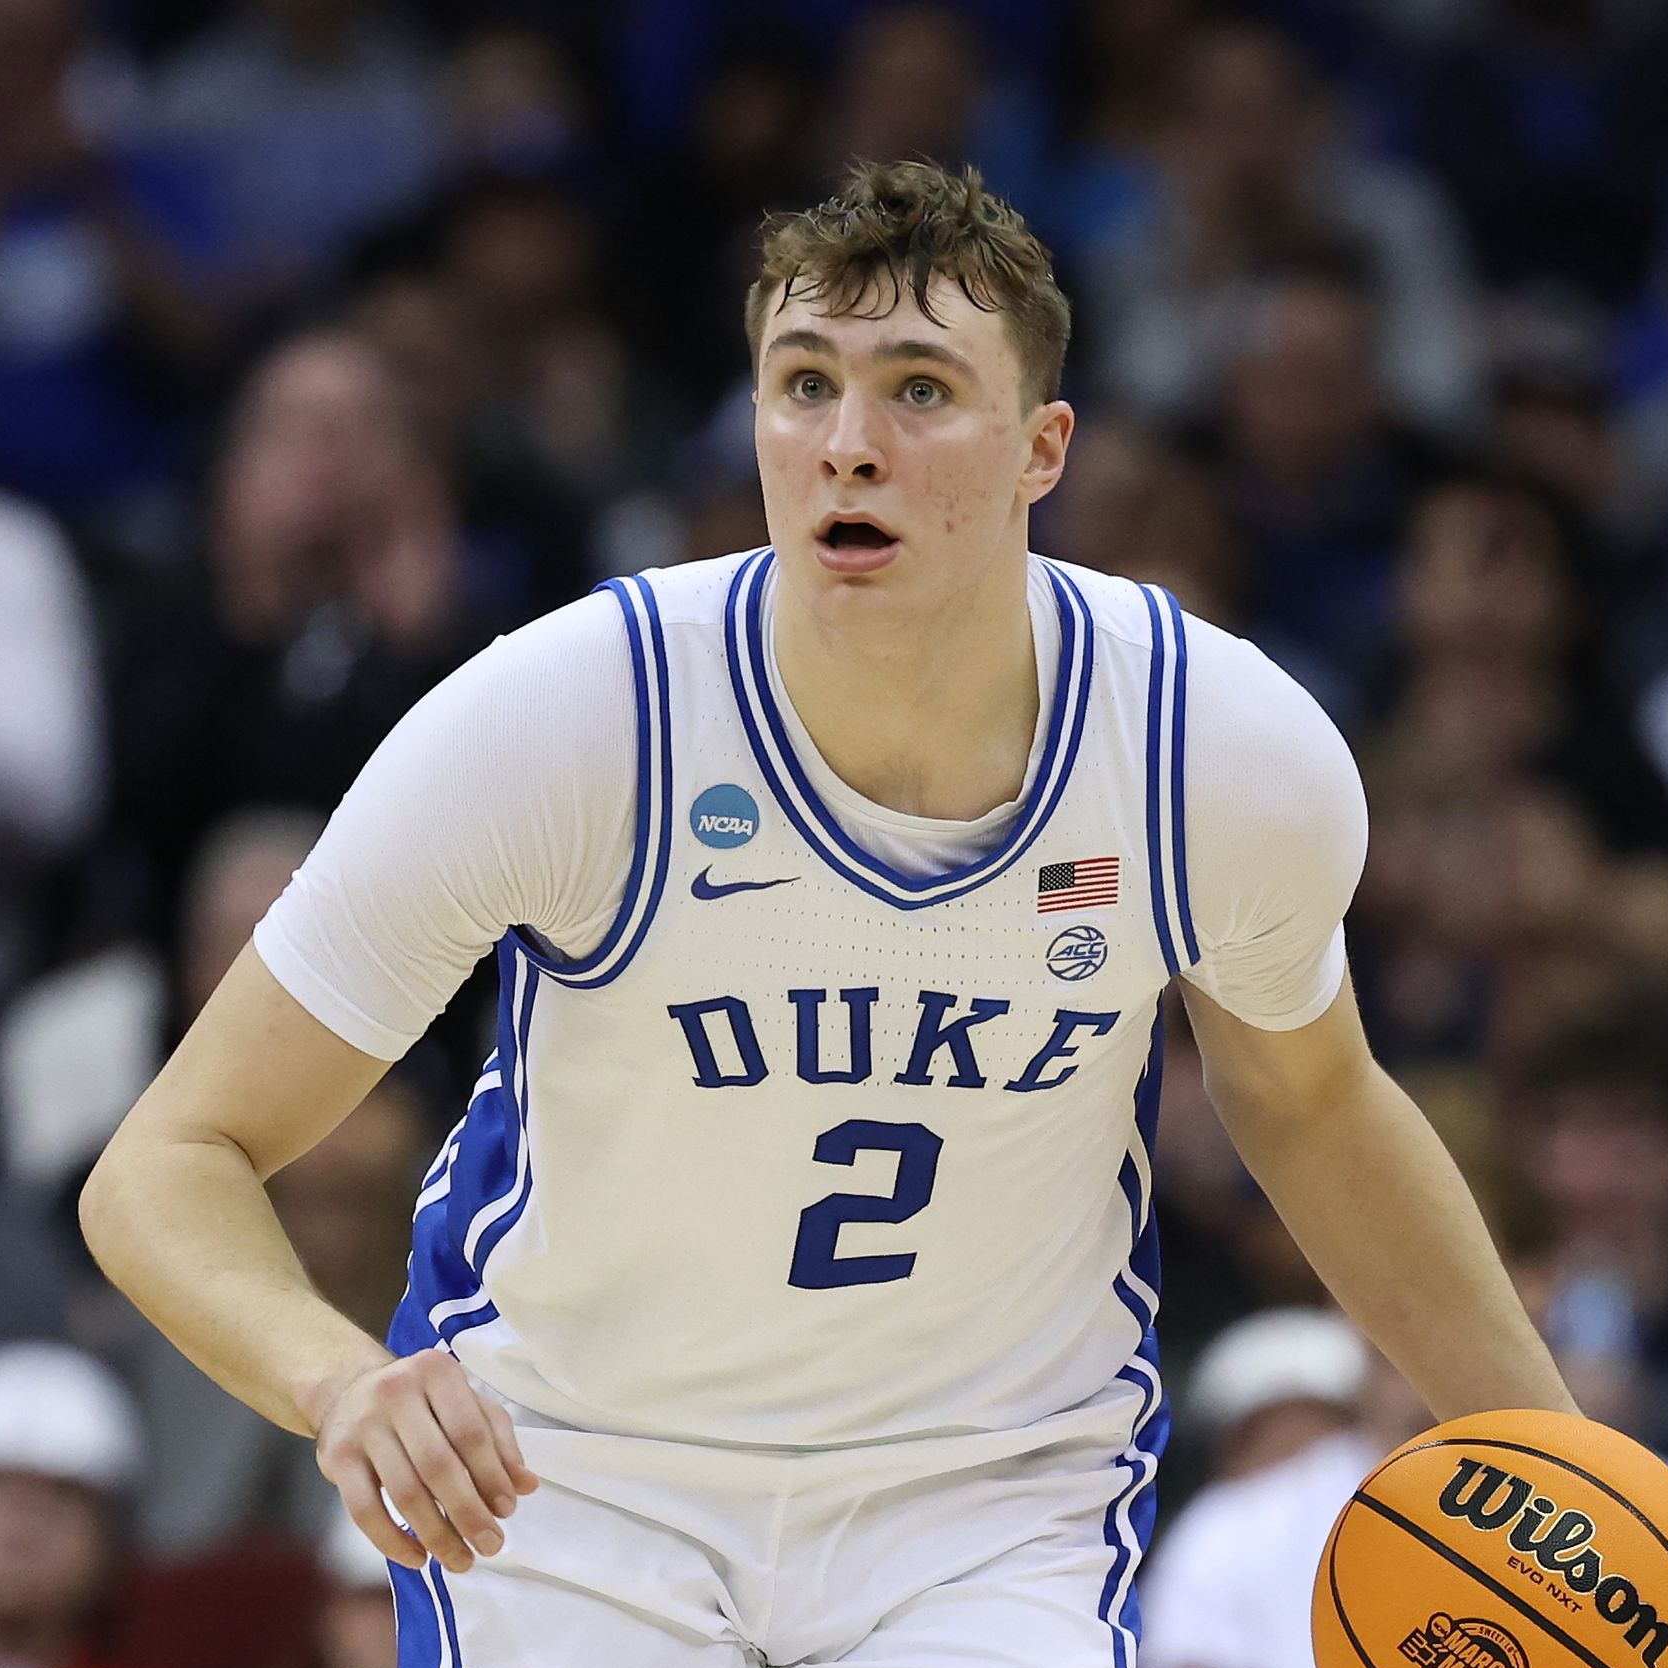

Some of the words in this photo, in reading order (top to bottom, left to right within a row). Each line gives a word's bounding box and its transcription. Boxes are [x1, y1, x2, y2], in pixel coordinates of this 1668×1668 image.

[698, 814, 753, 836] NCAA
[1054, 942, 1105, 957] ACC
[667, 987, 1121, 1092] DUKE
[787, 1119, 944, 1290] 2
[1506, 1556, 1544, 1584] EVO
[1546, 1582, 1583, 1612] NXT
